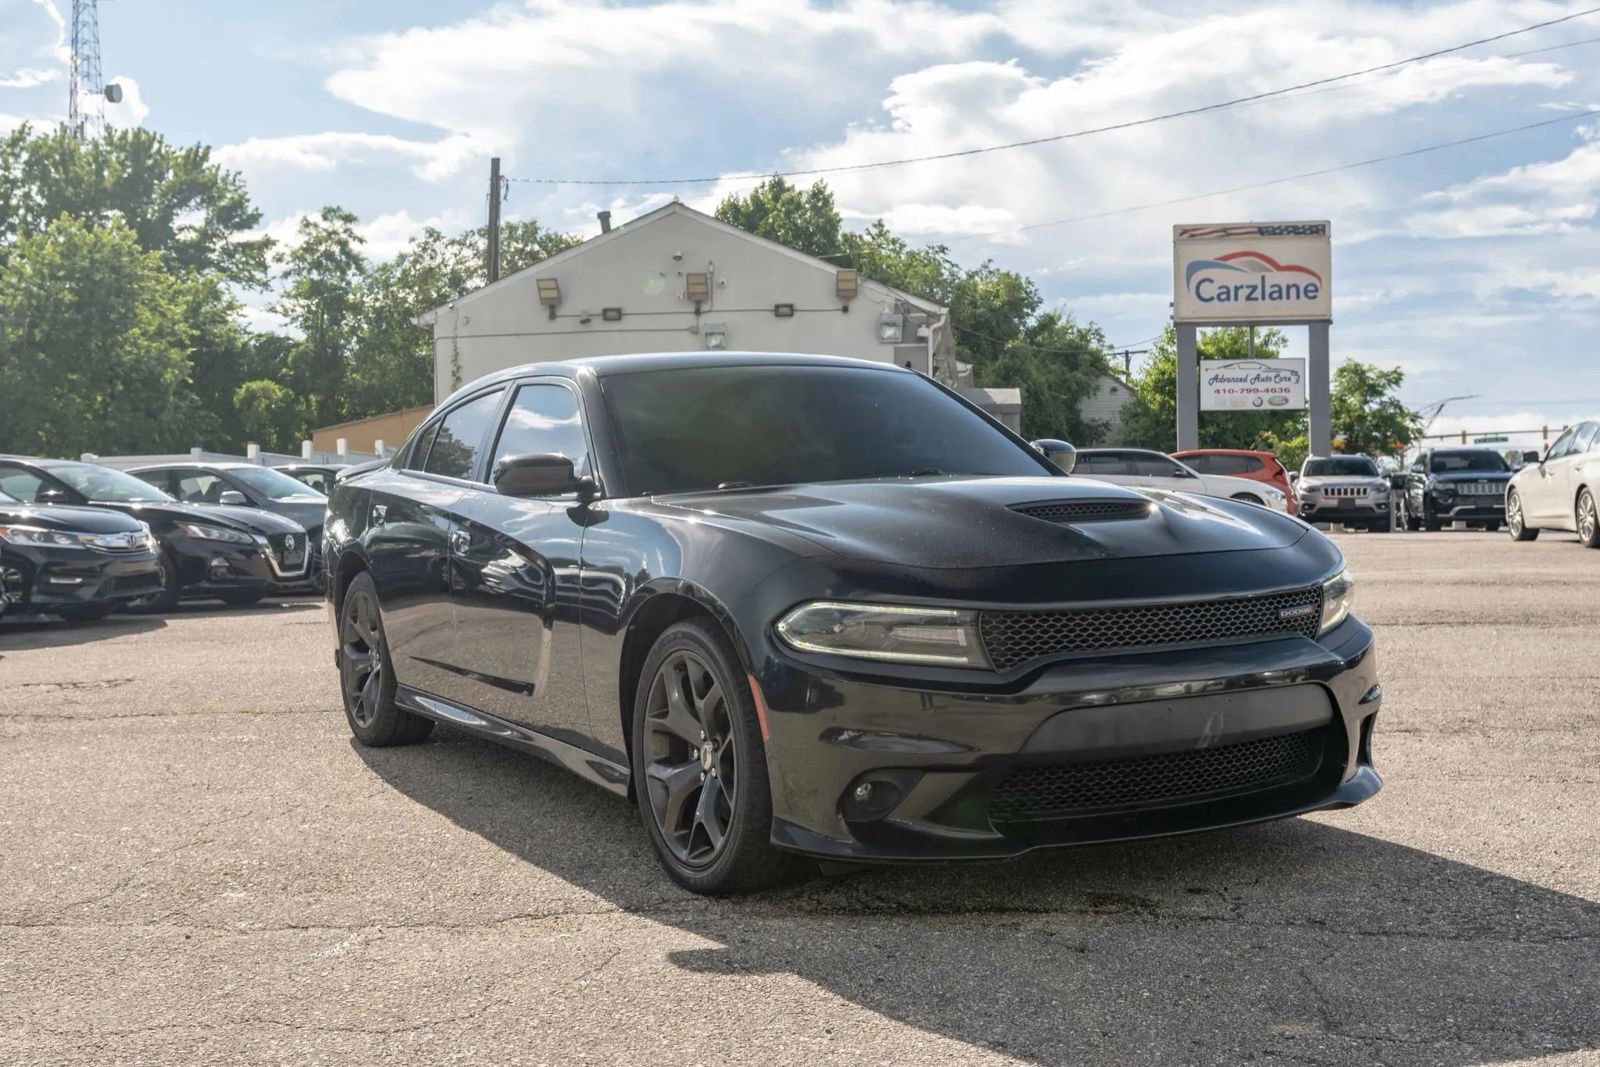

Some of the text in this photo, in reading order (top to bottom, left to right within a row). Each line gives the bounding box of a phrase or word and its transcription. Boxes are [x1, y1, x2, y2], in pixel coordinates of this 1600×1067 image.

[1195, 275, 1319, 302] Carzlane
[1208, 373, 1248, 386] Advanced
[1250, 373, 1273, 385] Auto
